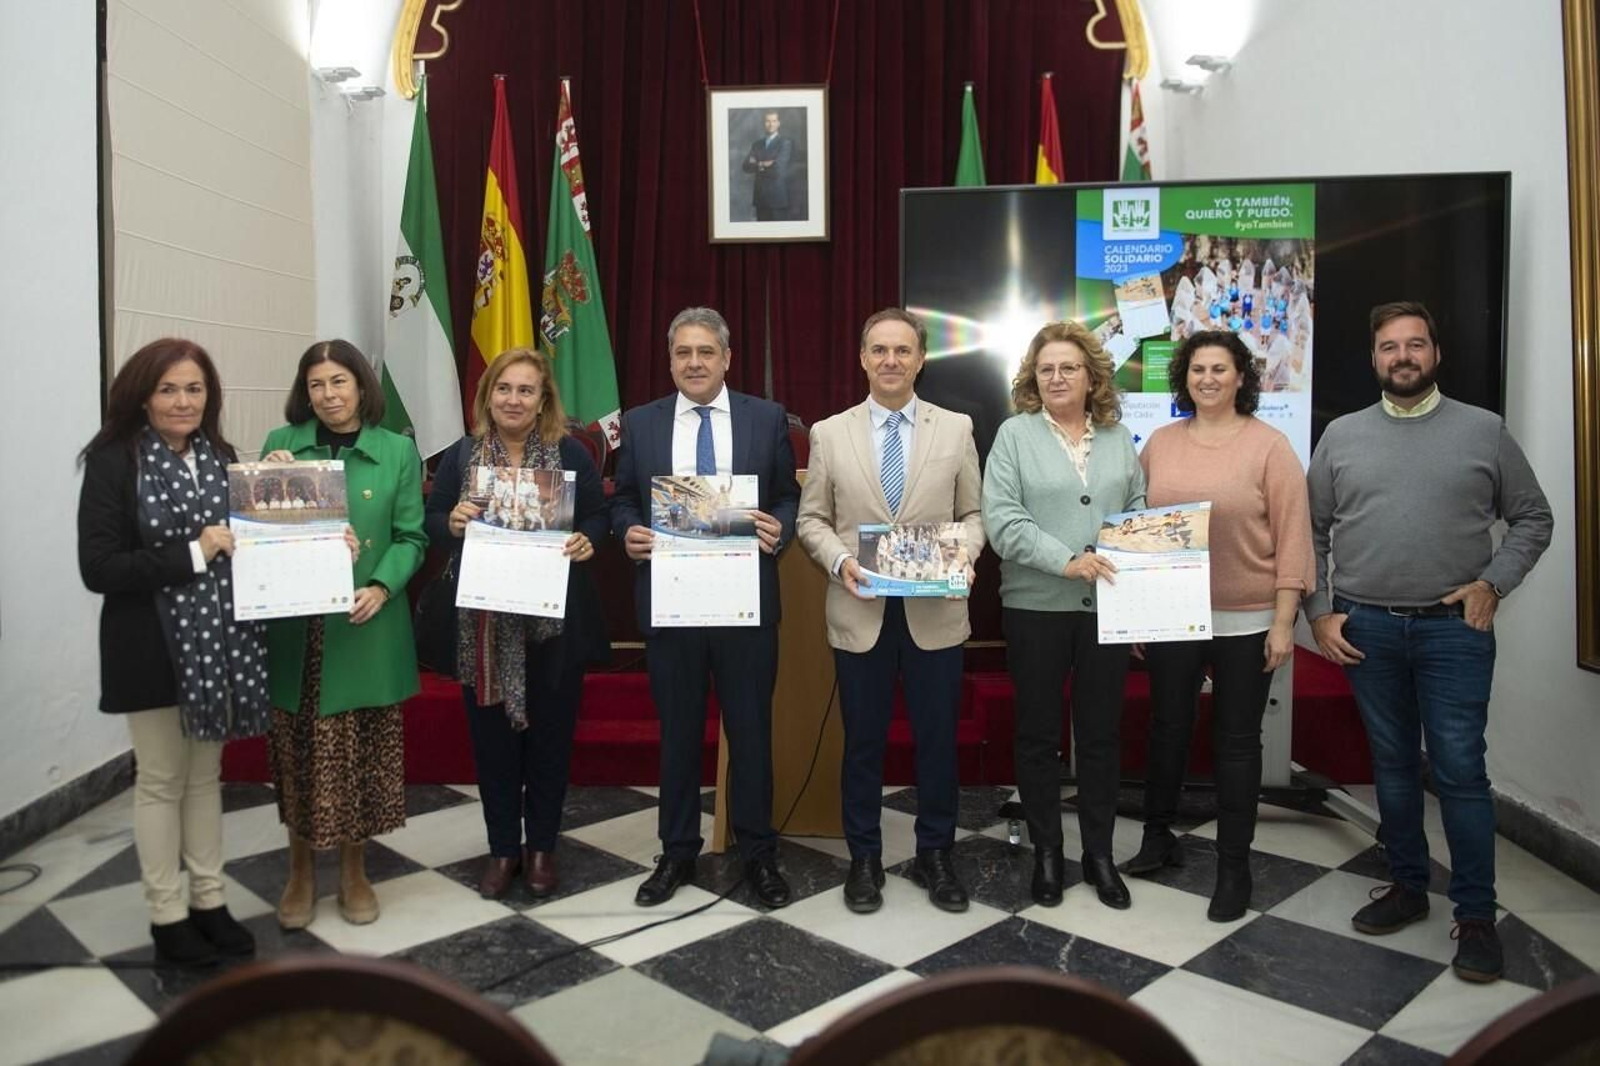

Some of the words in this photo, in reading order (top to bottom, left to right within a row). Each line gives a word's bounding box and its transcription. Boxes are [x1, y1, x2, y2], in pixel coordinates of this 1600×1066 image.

[1214, 198, 1232, 208] YO
[1185, 209, 1232, 219] QUIERO
[1236, 209, 1244, 218] Y
[1247, 207, 1294, 218] PUEDO.
[1104, 244, 1173, 254] CALENDARIO
[1104, 254, 1162, 263] SOLIDARIO
[1104, 264, 1128, 273] 2023
